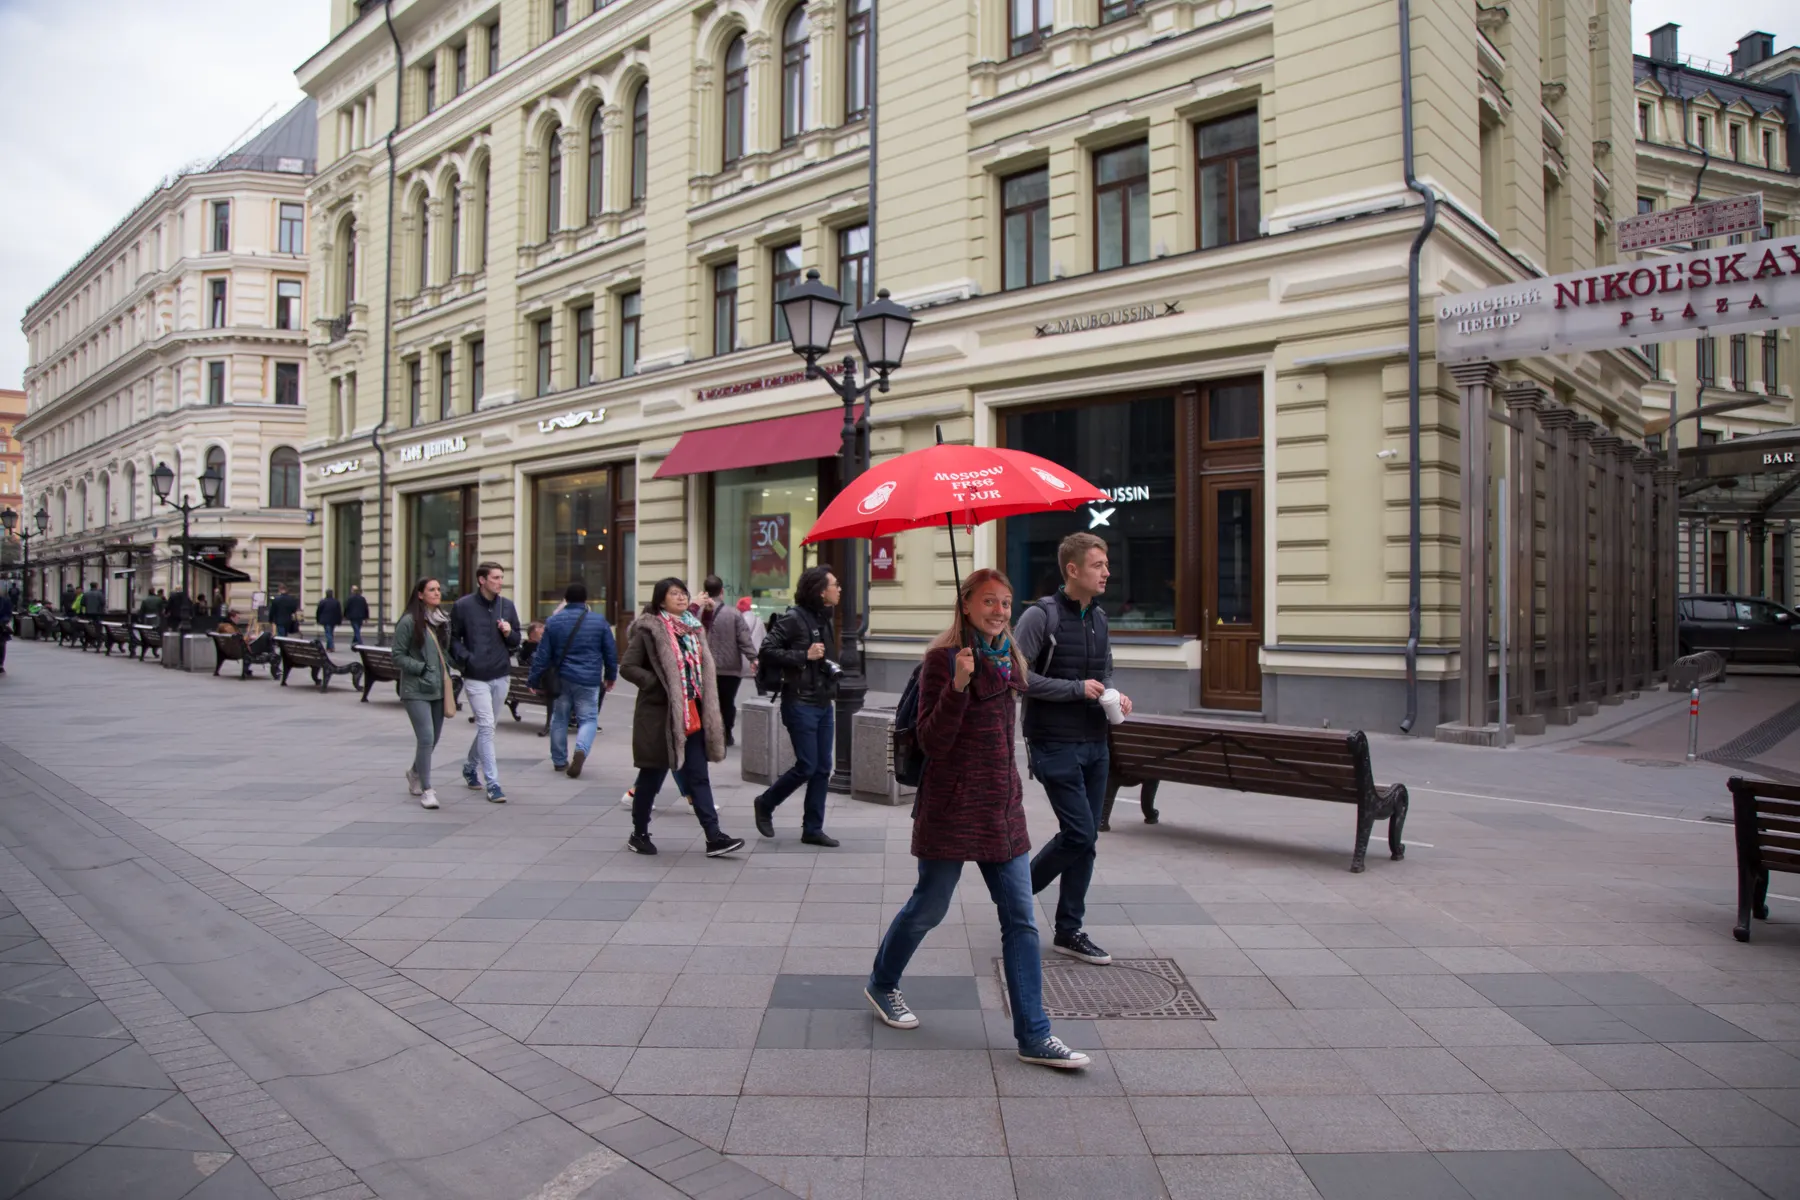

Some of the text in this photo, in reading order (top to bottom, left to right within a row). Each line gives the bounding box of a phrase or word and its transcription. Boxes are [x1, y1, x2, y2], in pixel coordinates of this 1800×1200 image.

[1439, 288, 1541, 320] ОФИСНЫЙ
[1620, 293, 1765, 327] PLAZA
[1058, 304, 1156, 333] MAUBOUSSIN
[1457, 311, 1520, 336] ЦЕНТР
[1763, 452, 1794, 465] BAR
[934, 465, 1003, 481] MOSCOW
[951, 478, 995, 490] FREE
